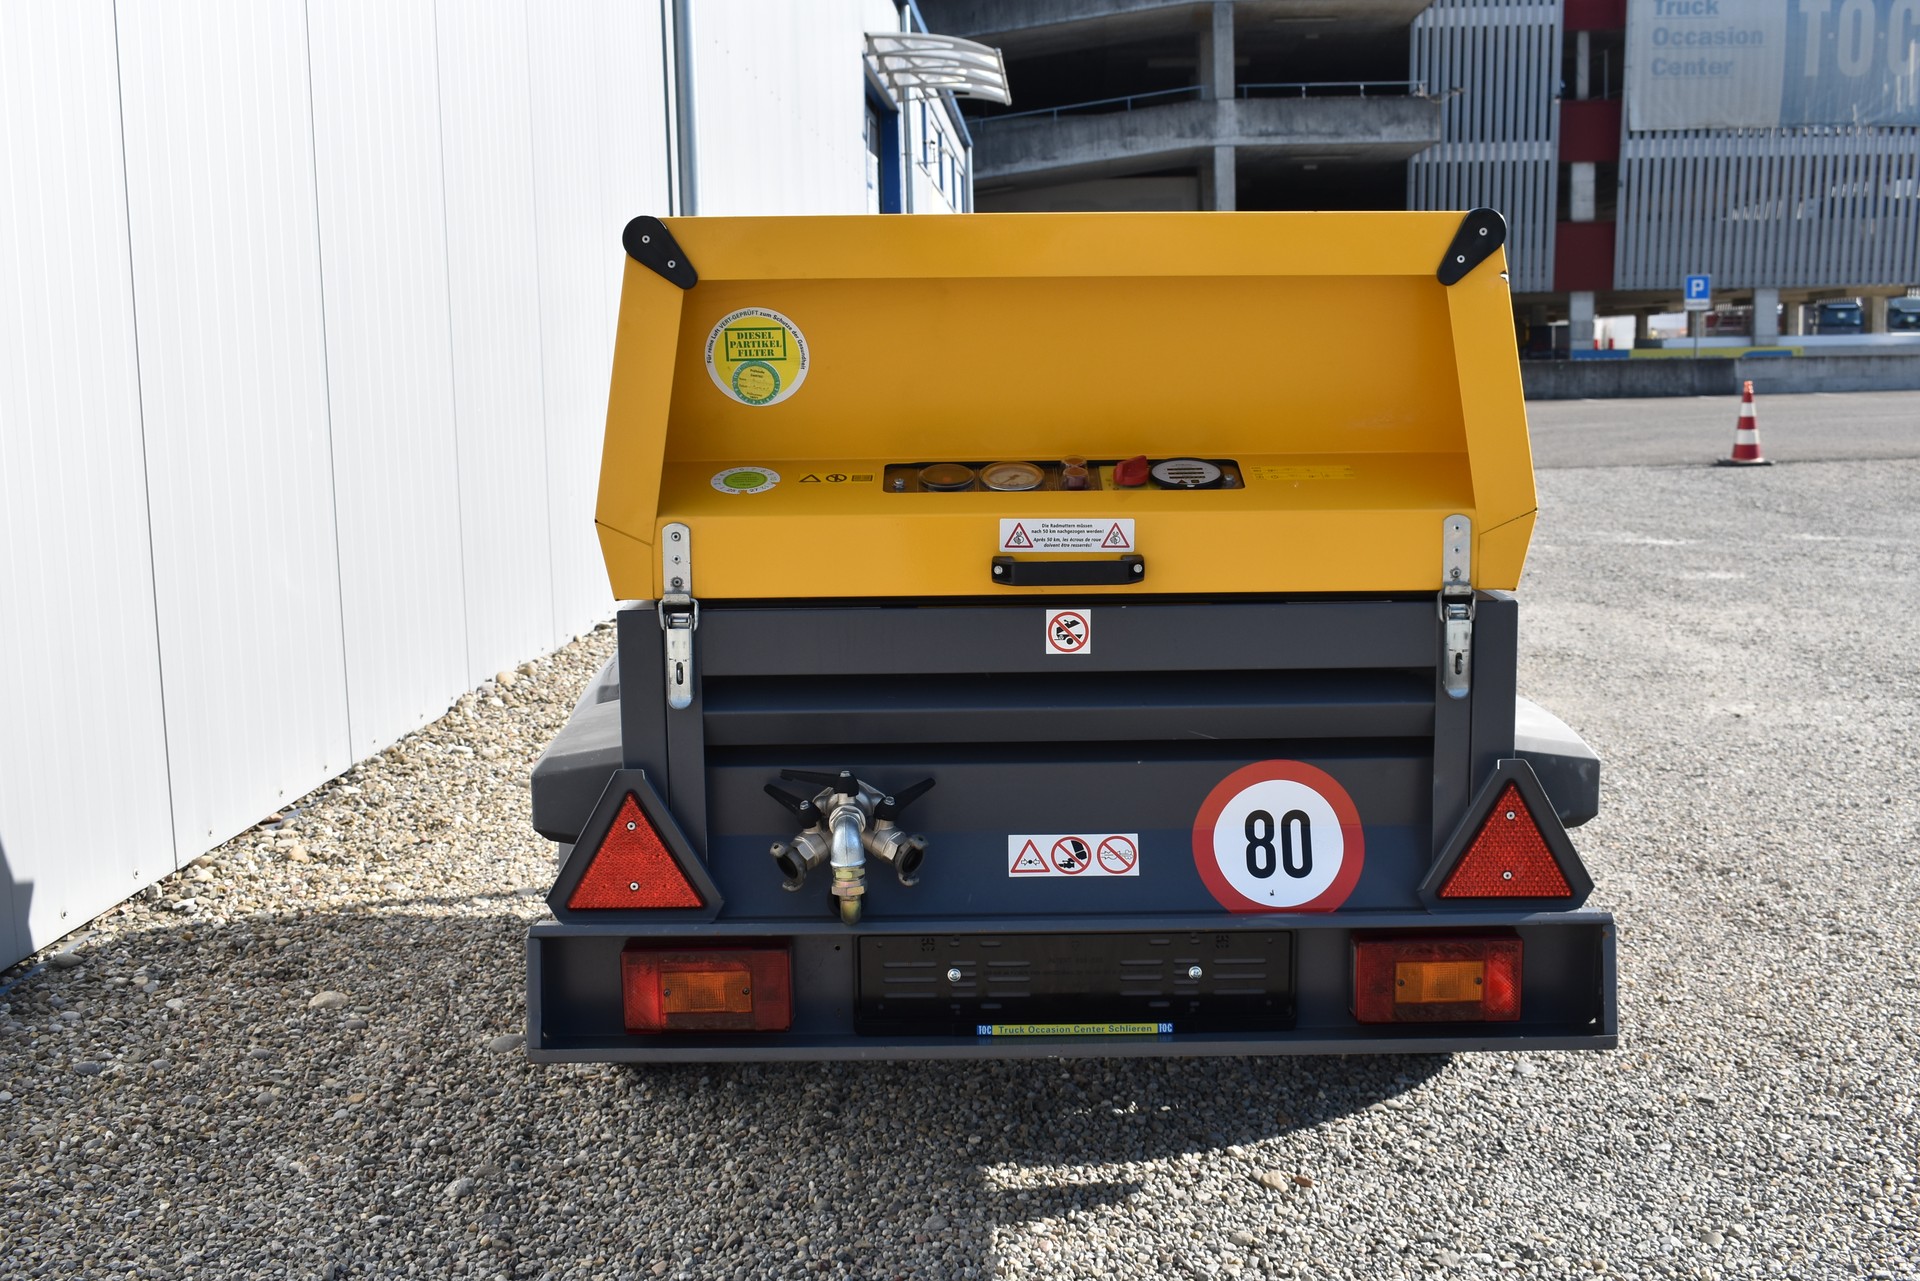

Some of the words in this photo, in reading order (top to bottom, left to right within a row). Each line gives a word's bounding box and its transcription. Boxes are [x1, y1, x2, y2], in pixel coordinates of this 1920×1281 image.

[1653, 0, 1719, 16] Truck
[1651, 26, 1764, 46] Occasion
[1650, 57, 1735, 76] Center
[1691, 279, 1705, 297] P
[710, 328, 721, 340] Luft
[772, 314, 793, 331] Schutze
[791, 330, 800, 340] der
[797, 339, 808, 371] Gesundheit
[729, 339, 783, 349] PARTIKEL
[736, 331, 775, 340] DIESEL
[737, 348, 775, 357] FILTER
[1244, 809, 1313, 879] 80
[998, 1025, 1025, 1034] Truck
[1027, 1025, 1071, 1034] Occasion
[1073, 1025, 1105, 1034] Center
[1108, 1024, 1153, 1033] Schlieren
